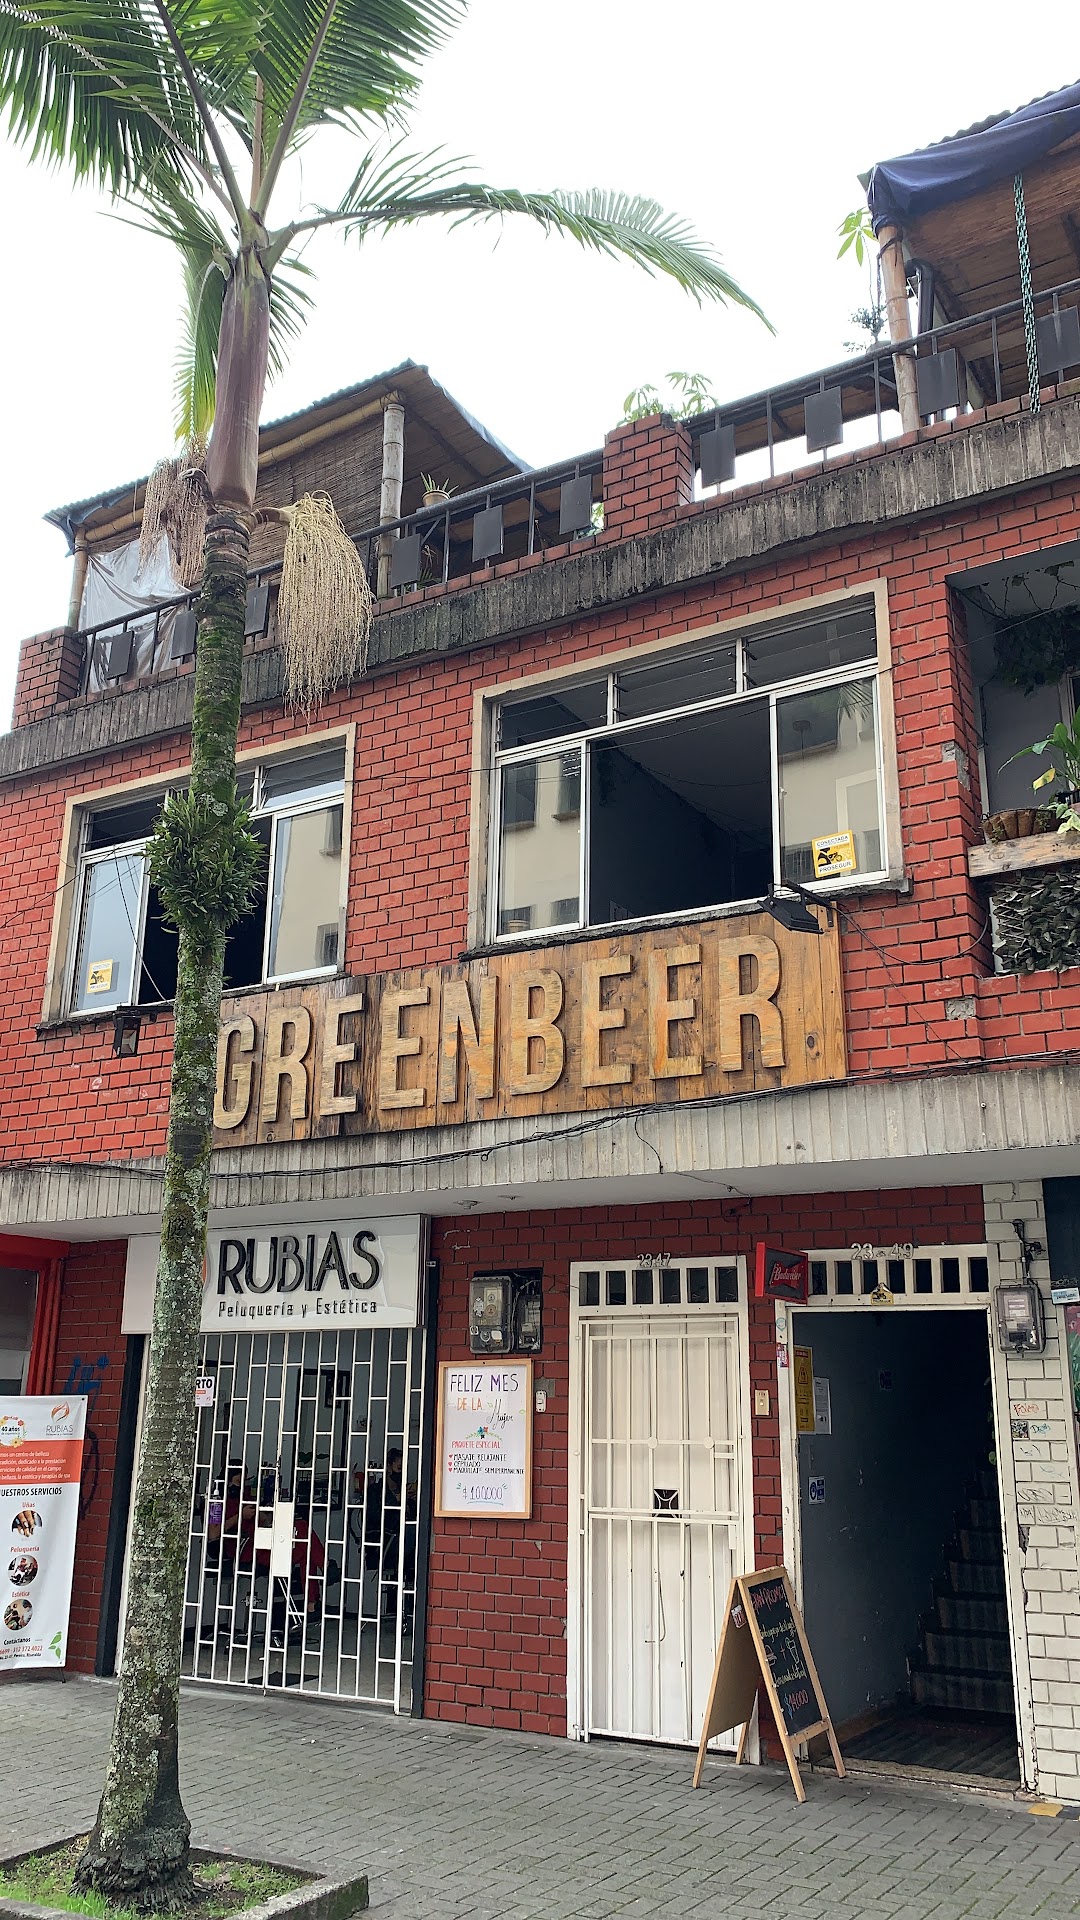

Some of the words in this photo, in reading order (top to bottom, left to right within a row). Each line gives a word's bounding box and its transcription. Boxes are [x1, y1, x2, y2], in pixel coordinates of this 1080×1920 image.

[217, 1231, 382, 1295] RUBIAS
[219, 1300, 294, 1319] Peluquería
[301, 1303, 308, 1318] y
[316, 1297, 378, 1315] Estética
[450, 1374, 483, 1393] FELIZ
[490, 1373, 519, 1392] MES
[457, 1397, 468, 1411] DE
[471, 1397, 483, 1411] LA
[45, 1424, 74, 1433] RUBIAS
[0, 1487, 30, 1497] UESTROS
[30, 1486, 63, 1496] SERVICIOS
[10, 1546, 40, 1554] Peluquería
